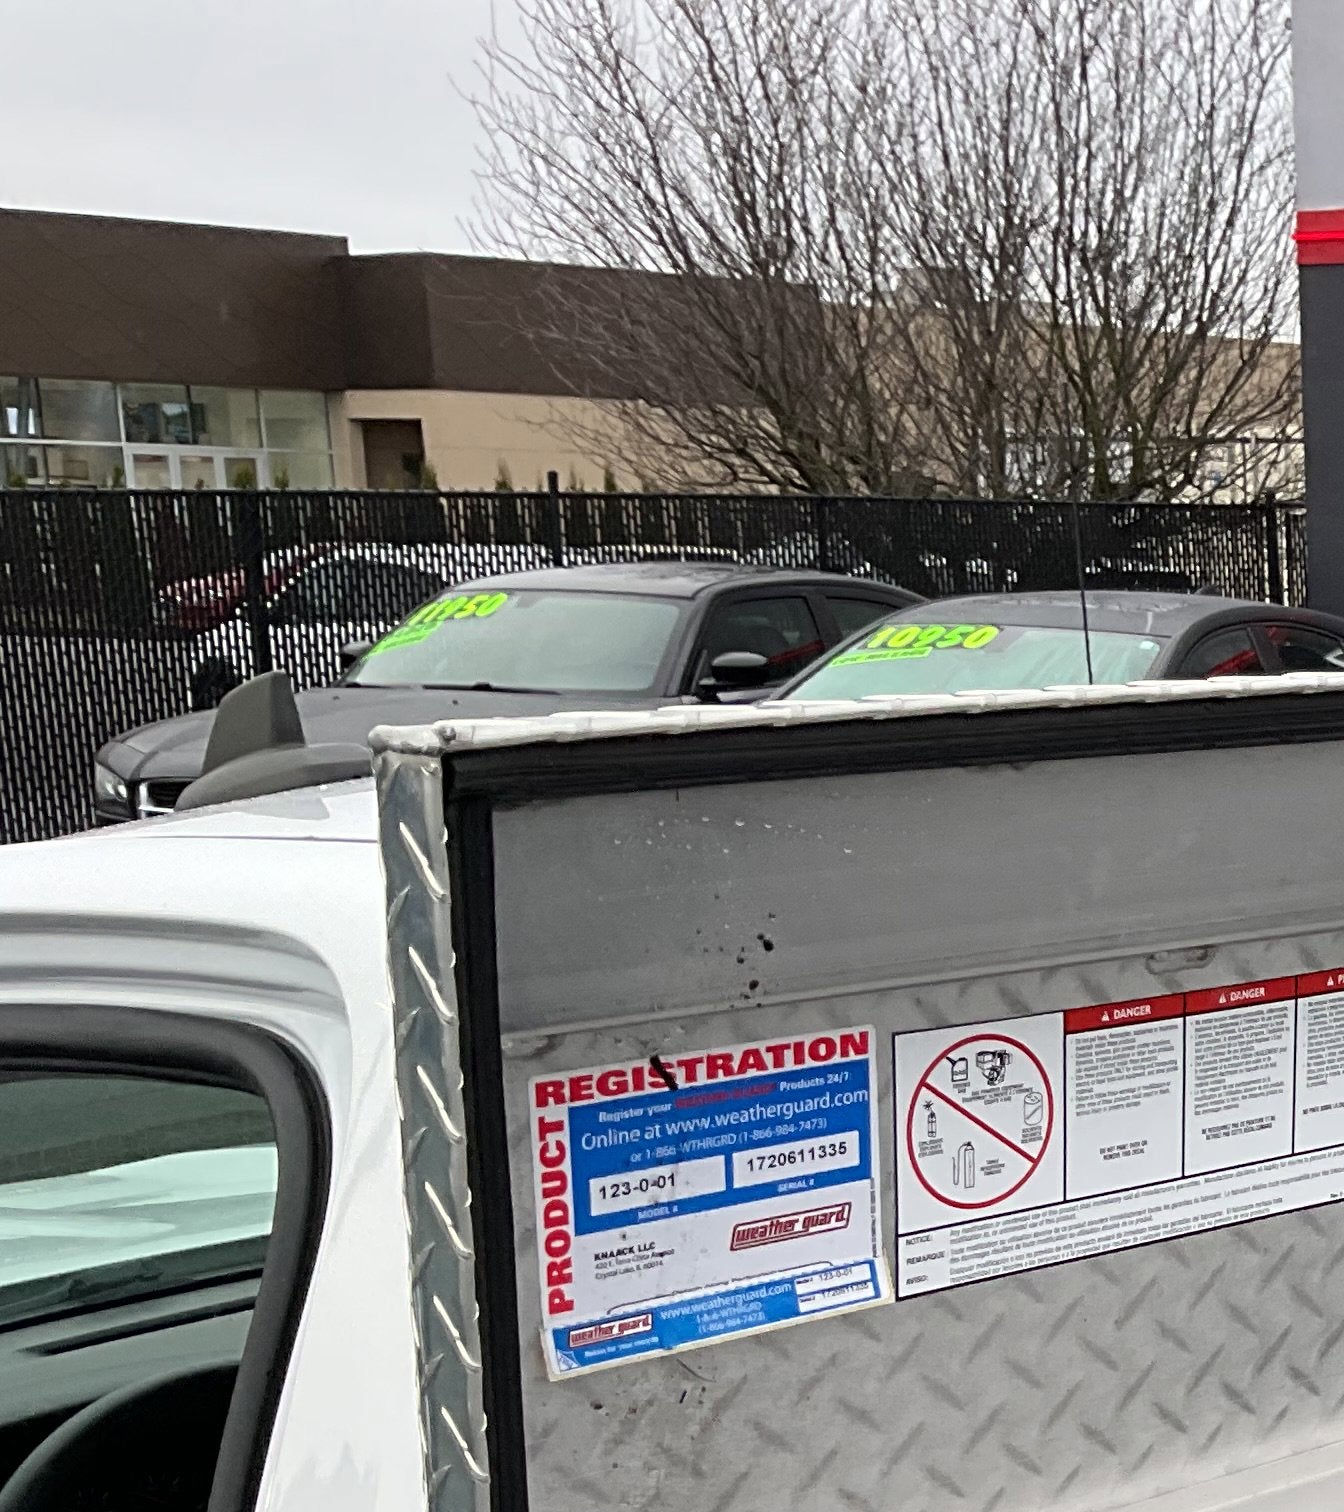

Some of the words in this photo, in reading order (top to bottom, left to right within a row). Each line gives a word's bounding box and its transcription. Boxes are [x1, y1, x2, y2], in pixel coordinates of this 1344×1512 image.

[866, 624, 1000, 649] 10950
[1229, 987, 1265, 1001] DANGER
[1113, 1004, 1152, 1020] DANGER
[534, 1030, 869, 1108] REGISTRATION
[779, 1076, 825, 1091] Products
[826, 1070, 849, 1085] 24/7
[581, 1128, 641, 1150] Online
[644, 1123, 660, 1140] at
[665, 1089, 869, 1136] www.weatherguard.com
[599, 1107, 644, 1123] Register
[647, 1102, 672, 1116] your
[630, 1152, 642, 1163] or
[747, 1141, 847, 1173] 1720611335
[599, 1172, 676, 1200] 123-0-01
[777, 1180, 808, 1193] SERIAL
[538, 1115, 575, 1315] PRODUCT
[637, 1206, 671, 1222] MODEL
[735, 1218, 800, 1243] weather
[801, 1205, 846, 1232] guard
[593, 1245, 634, 1262] KNAACK
[636, 1241, 656, 1253] LLC
[660, 1283, 792, 1321] www.weatherguard.com
[571, 1325, 614, 1344] weather
[617, 1316, 650, 1335] guard
